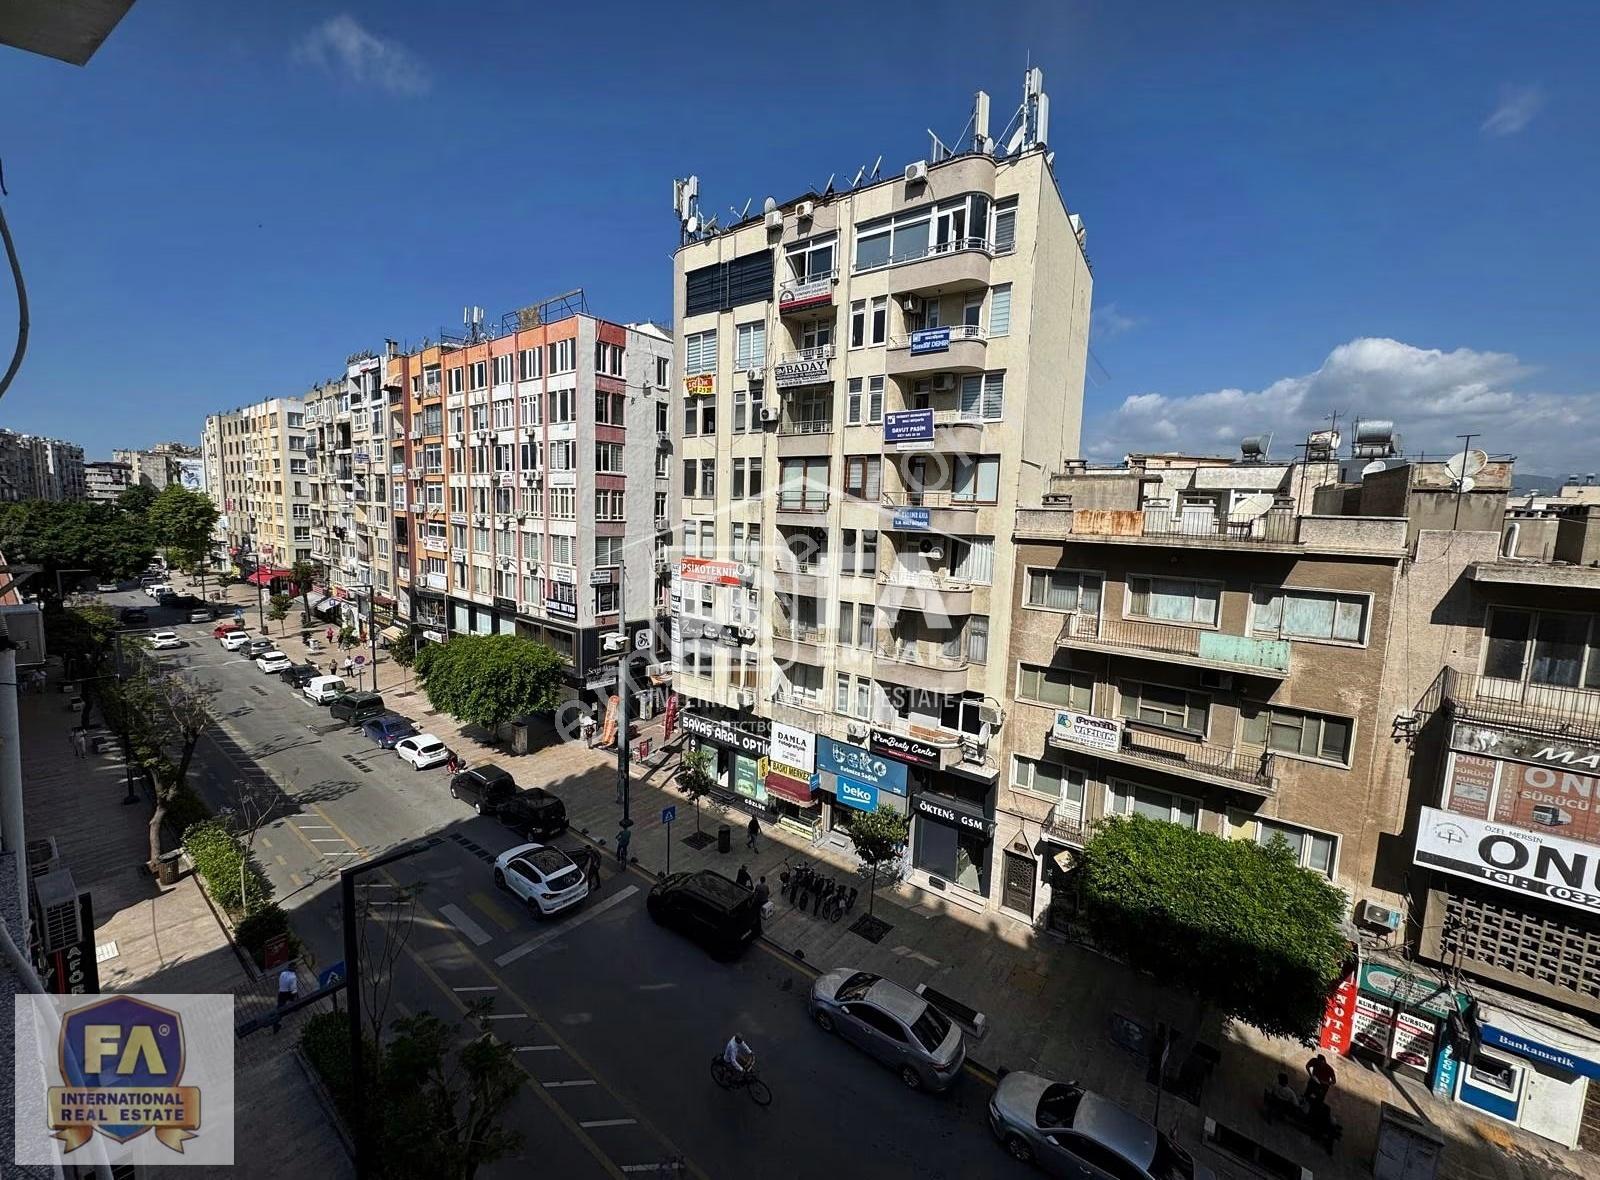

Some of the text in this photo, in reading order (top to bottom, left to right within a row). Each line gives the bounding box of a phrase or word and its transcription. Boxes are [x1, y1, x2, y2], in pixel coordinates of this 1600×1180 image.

[786, 360, 825, 373] BADAY
[715, 728, 740, 745] ARAL
[778, 732, 806, 747] DAMLA
[911, 744, 936, 756] Center
[1456, 755, 1495, 768] ONUR
[1455, 767, 1494, 780] SÜRÜCÜ
[1456, 775, 1489, 786] KURSU
[1524, 766, 1600, 798] ON
[843, 782, 872, 801] beko
[1520, 791, 1589, 811] SÜRÜCÜ
[961, 816, 983, 830] GSM
[1478, 834, 1600, 891] ON
[1400, 1014, 1434, 1033] KURSUNA
[1499, 1035, 1575, 1068] Bankamatik
